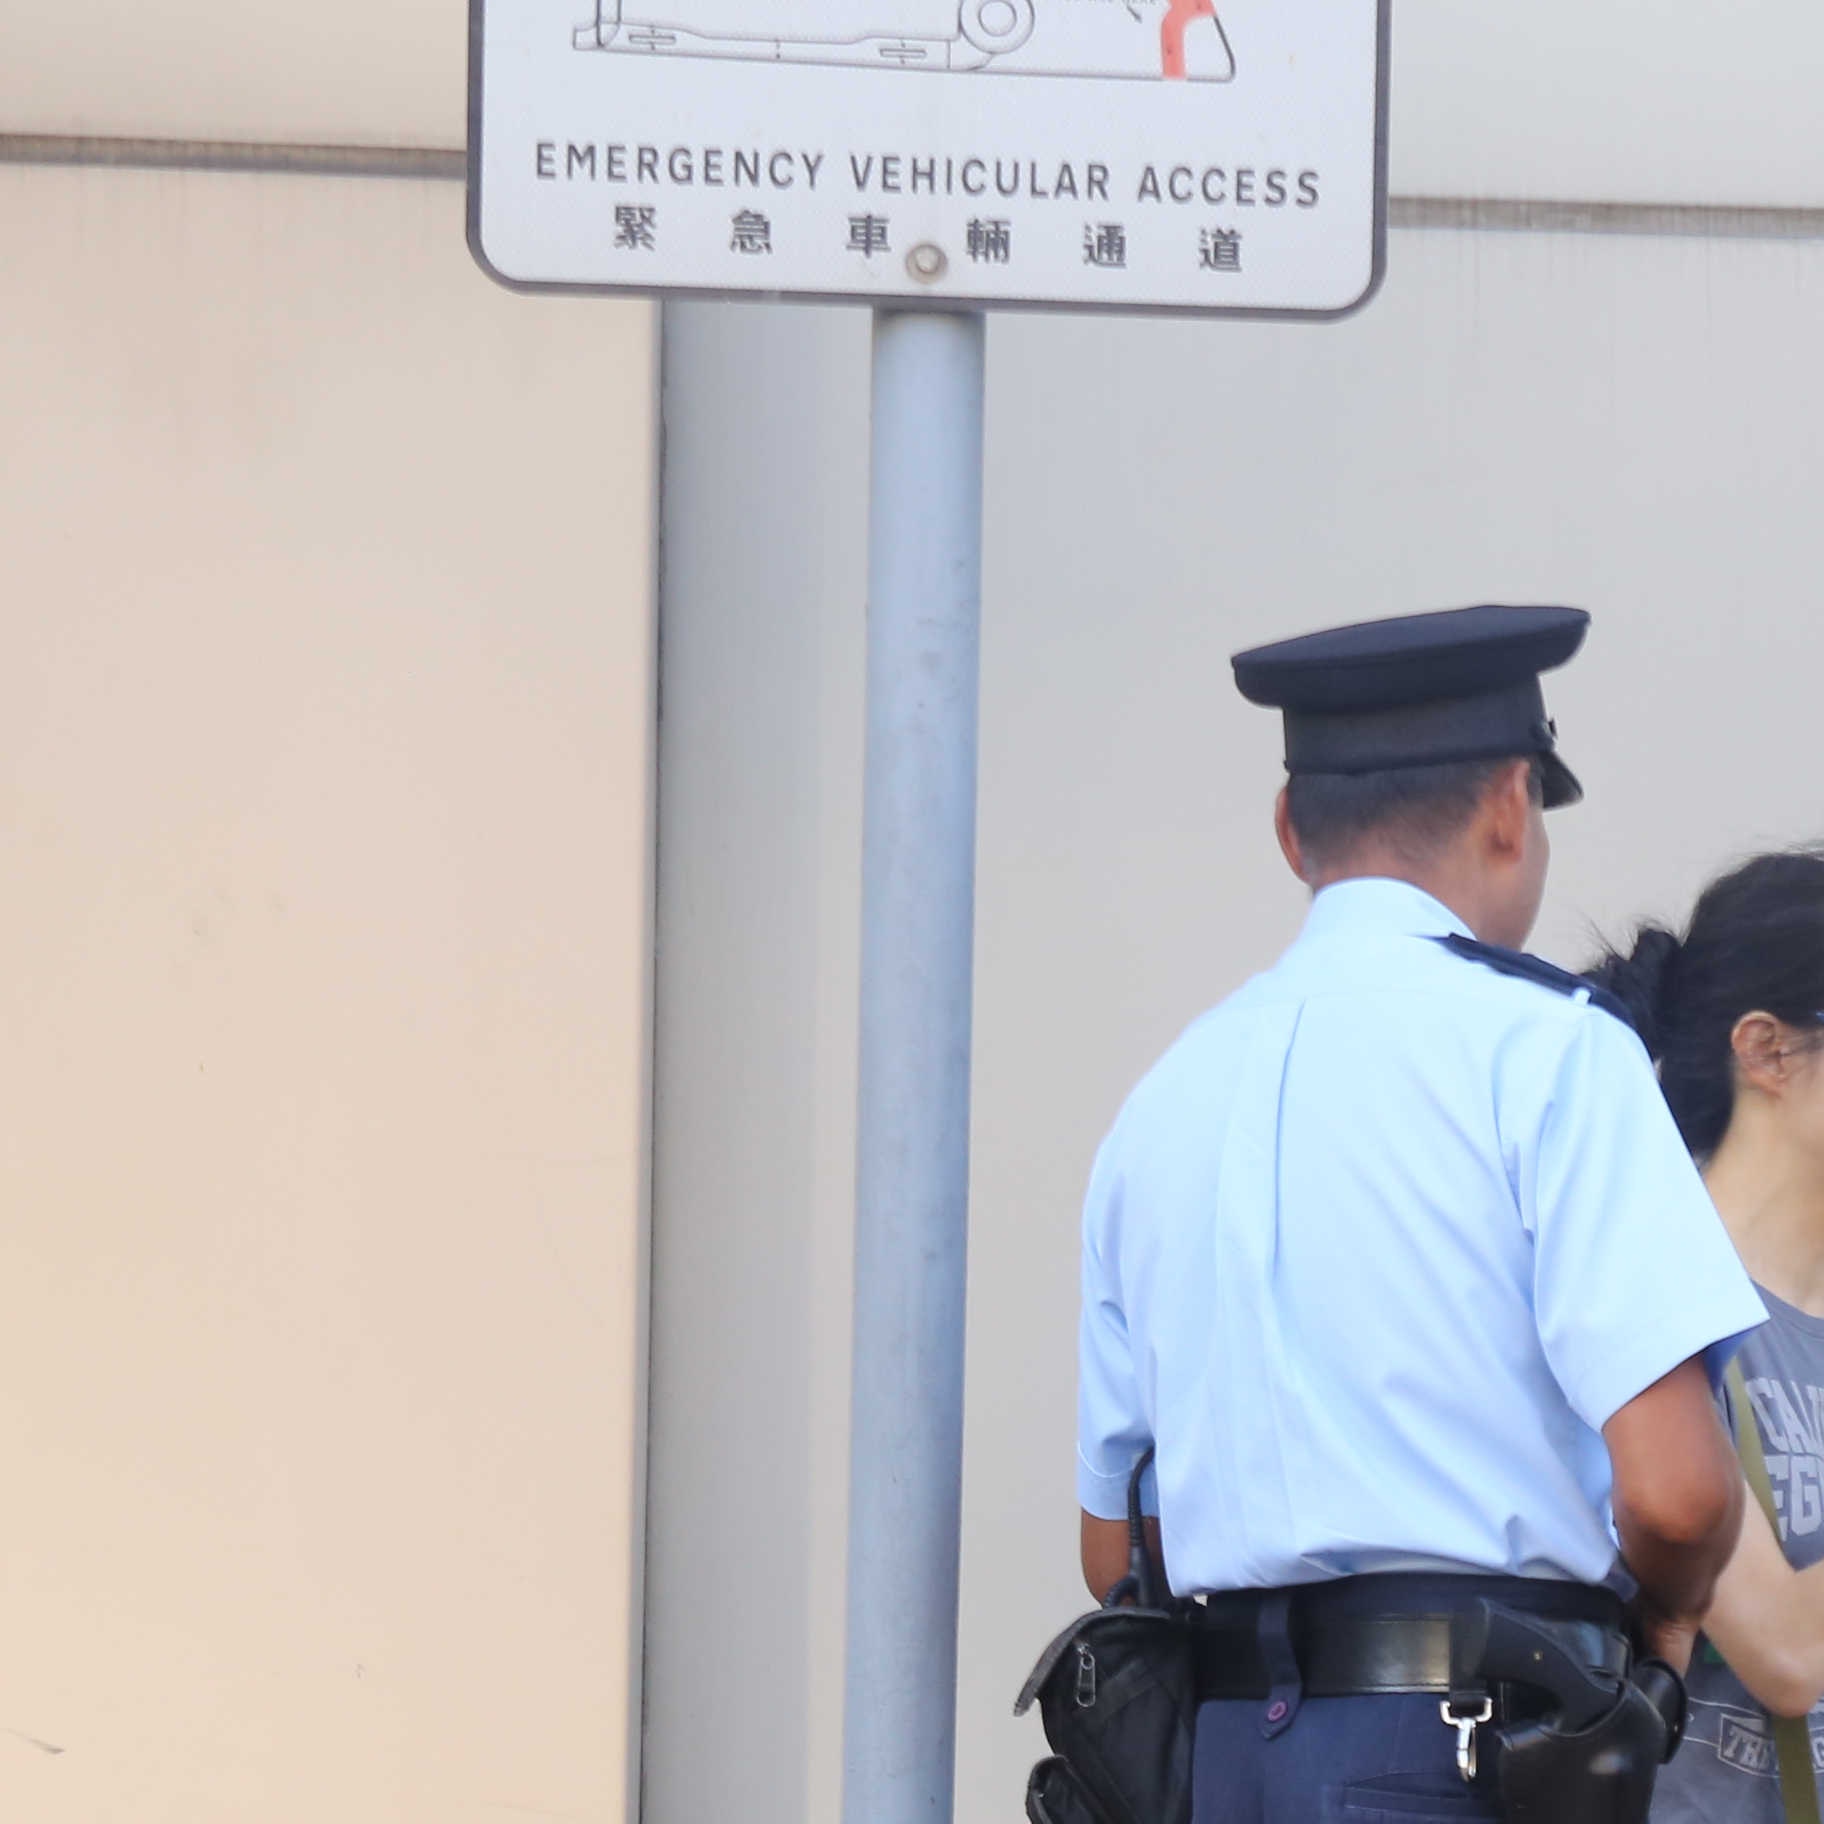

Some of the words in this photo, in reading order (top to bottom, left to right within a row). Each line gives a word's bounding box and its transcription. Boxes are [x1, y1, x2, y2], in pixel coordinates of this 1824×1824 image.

[535, 142, 824, 190] EMERGENCY
[850, 153, 1110, 202] VEHICULAR
[1137, 165, 1320, 208] ACCESS
[614, 204, 1243, 273] 緊急車輛通道
